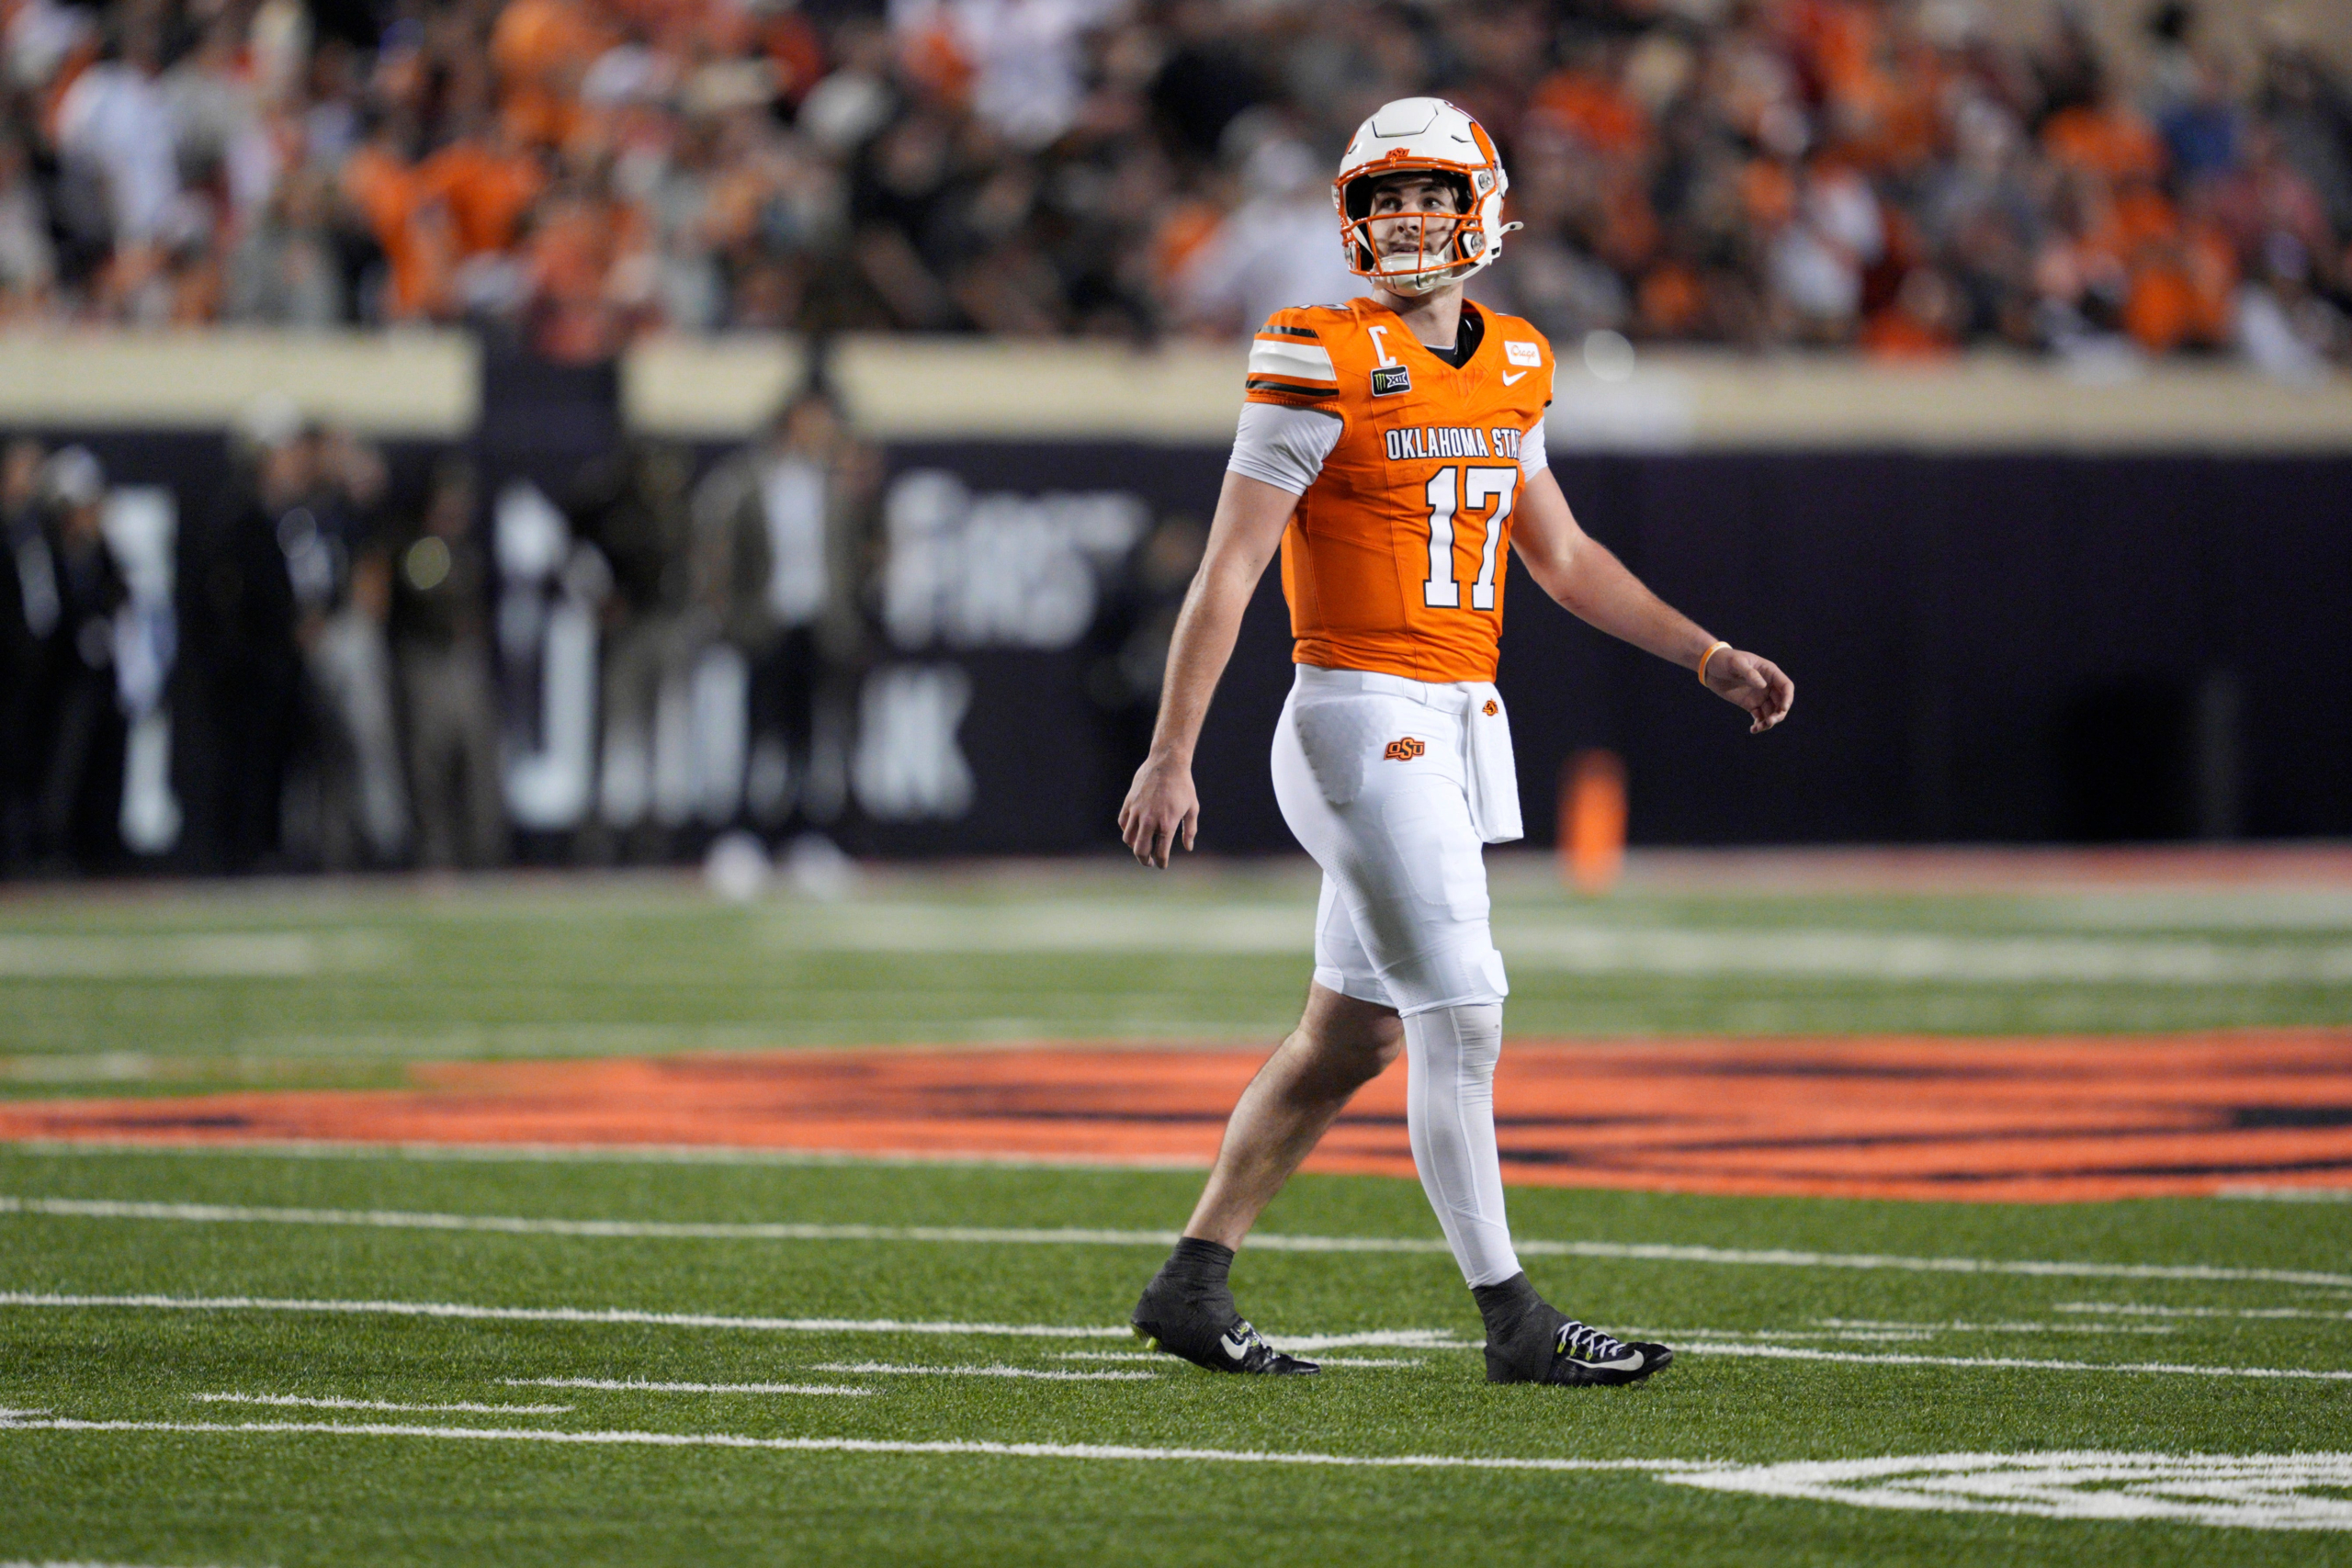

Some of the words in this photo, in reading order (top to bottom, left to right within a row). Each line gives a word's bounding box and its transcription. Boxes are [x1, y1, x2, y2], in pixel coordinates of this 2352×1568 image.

[1368, 325, 1396, 367] C
[1385, 427, 1490, 460] OKLAHOMA
[1490, 427, 1521, 459] STAT
[1423, 466, 1519, 611] 17
[1384, 737, 1425, 761] OSU
